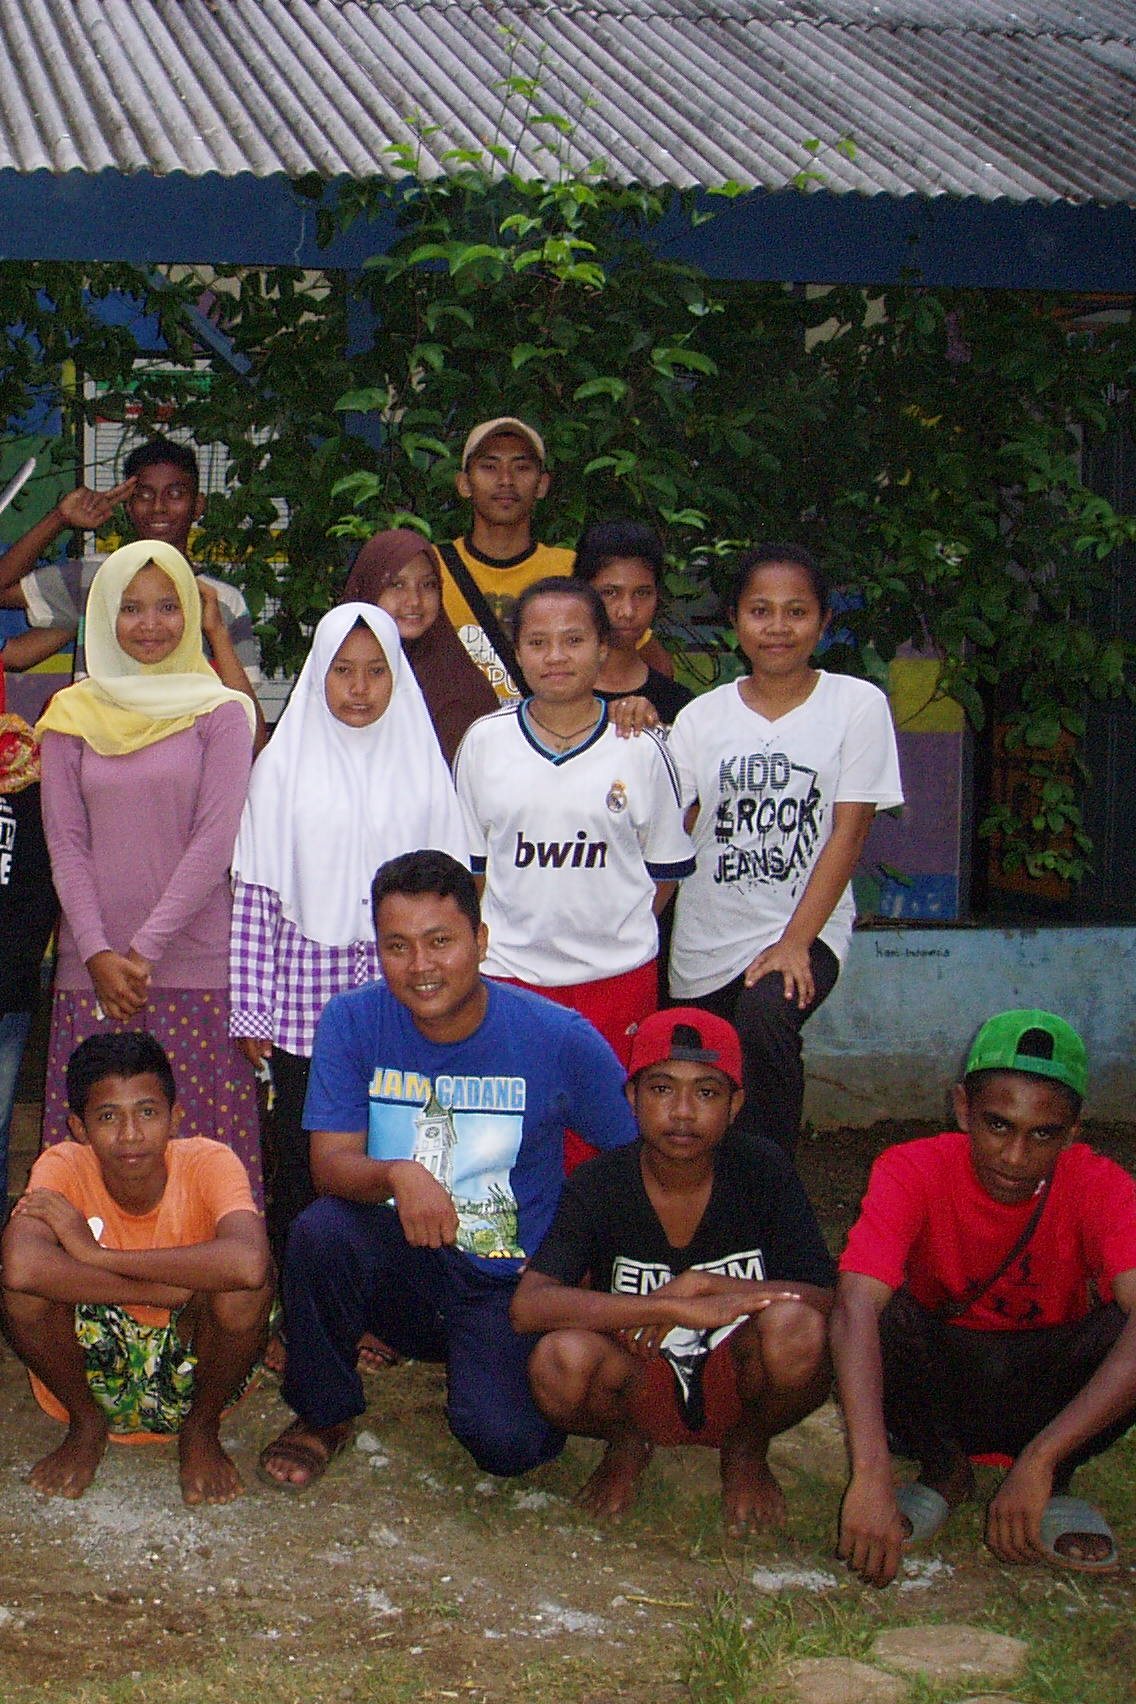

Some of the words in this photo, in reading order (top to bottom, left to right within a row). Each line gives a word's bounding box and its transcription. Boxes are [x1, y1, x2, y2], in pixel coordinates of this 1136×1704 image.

[719, 752, 790, 793] KIDD
[514, 831, 608, 868] bwin
[713, 845, 785, 884] JEANS
[369, 1068, 431, 1102] JAM
[436, 1076, 526, 1110] GADANG
